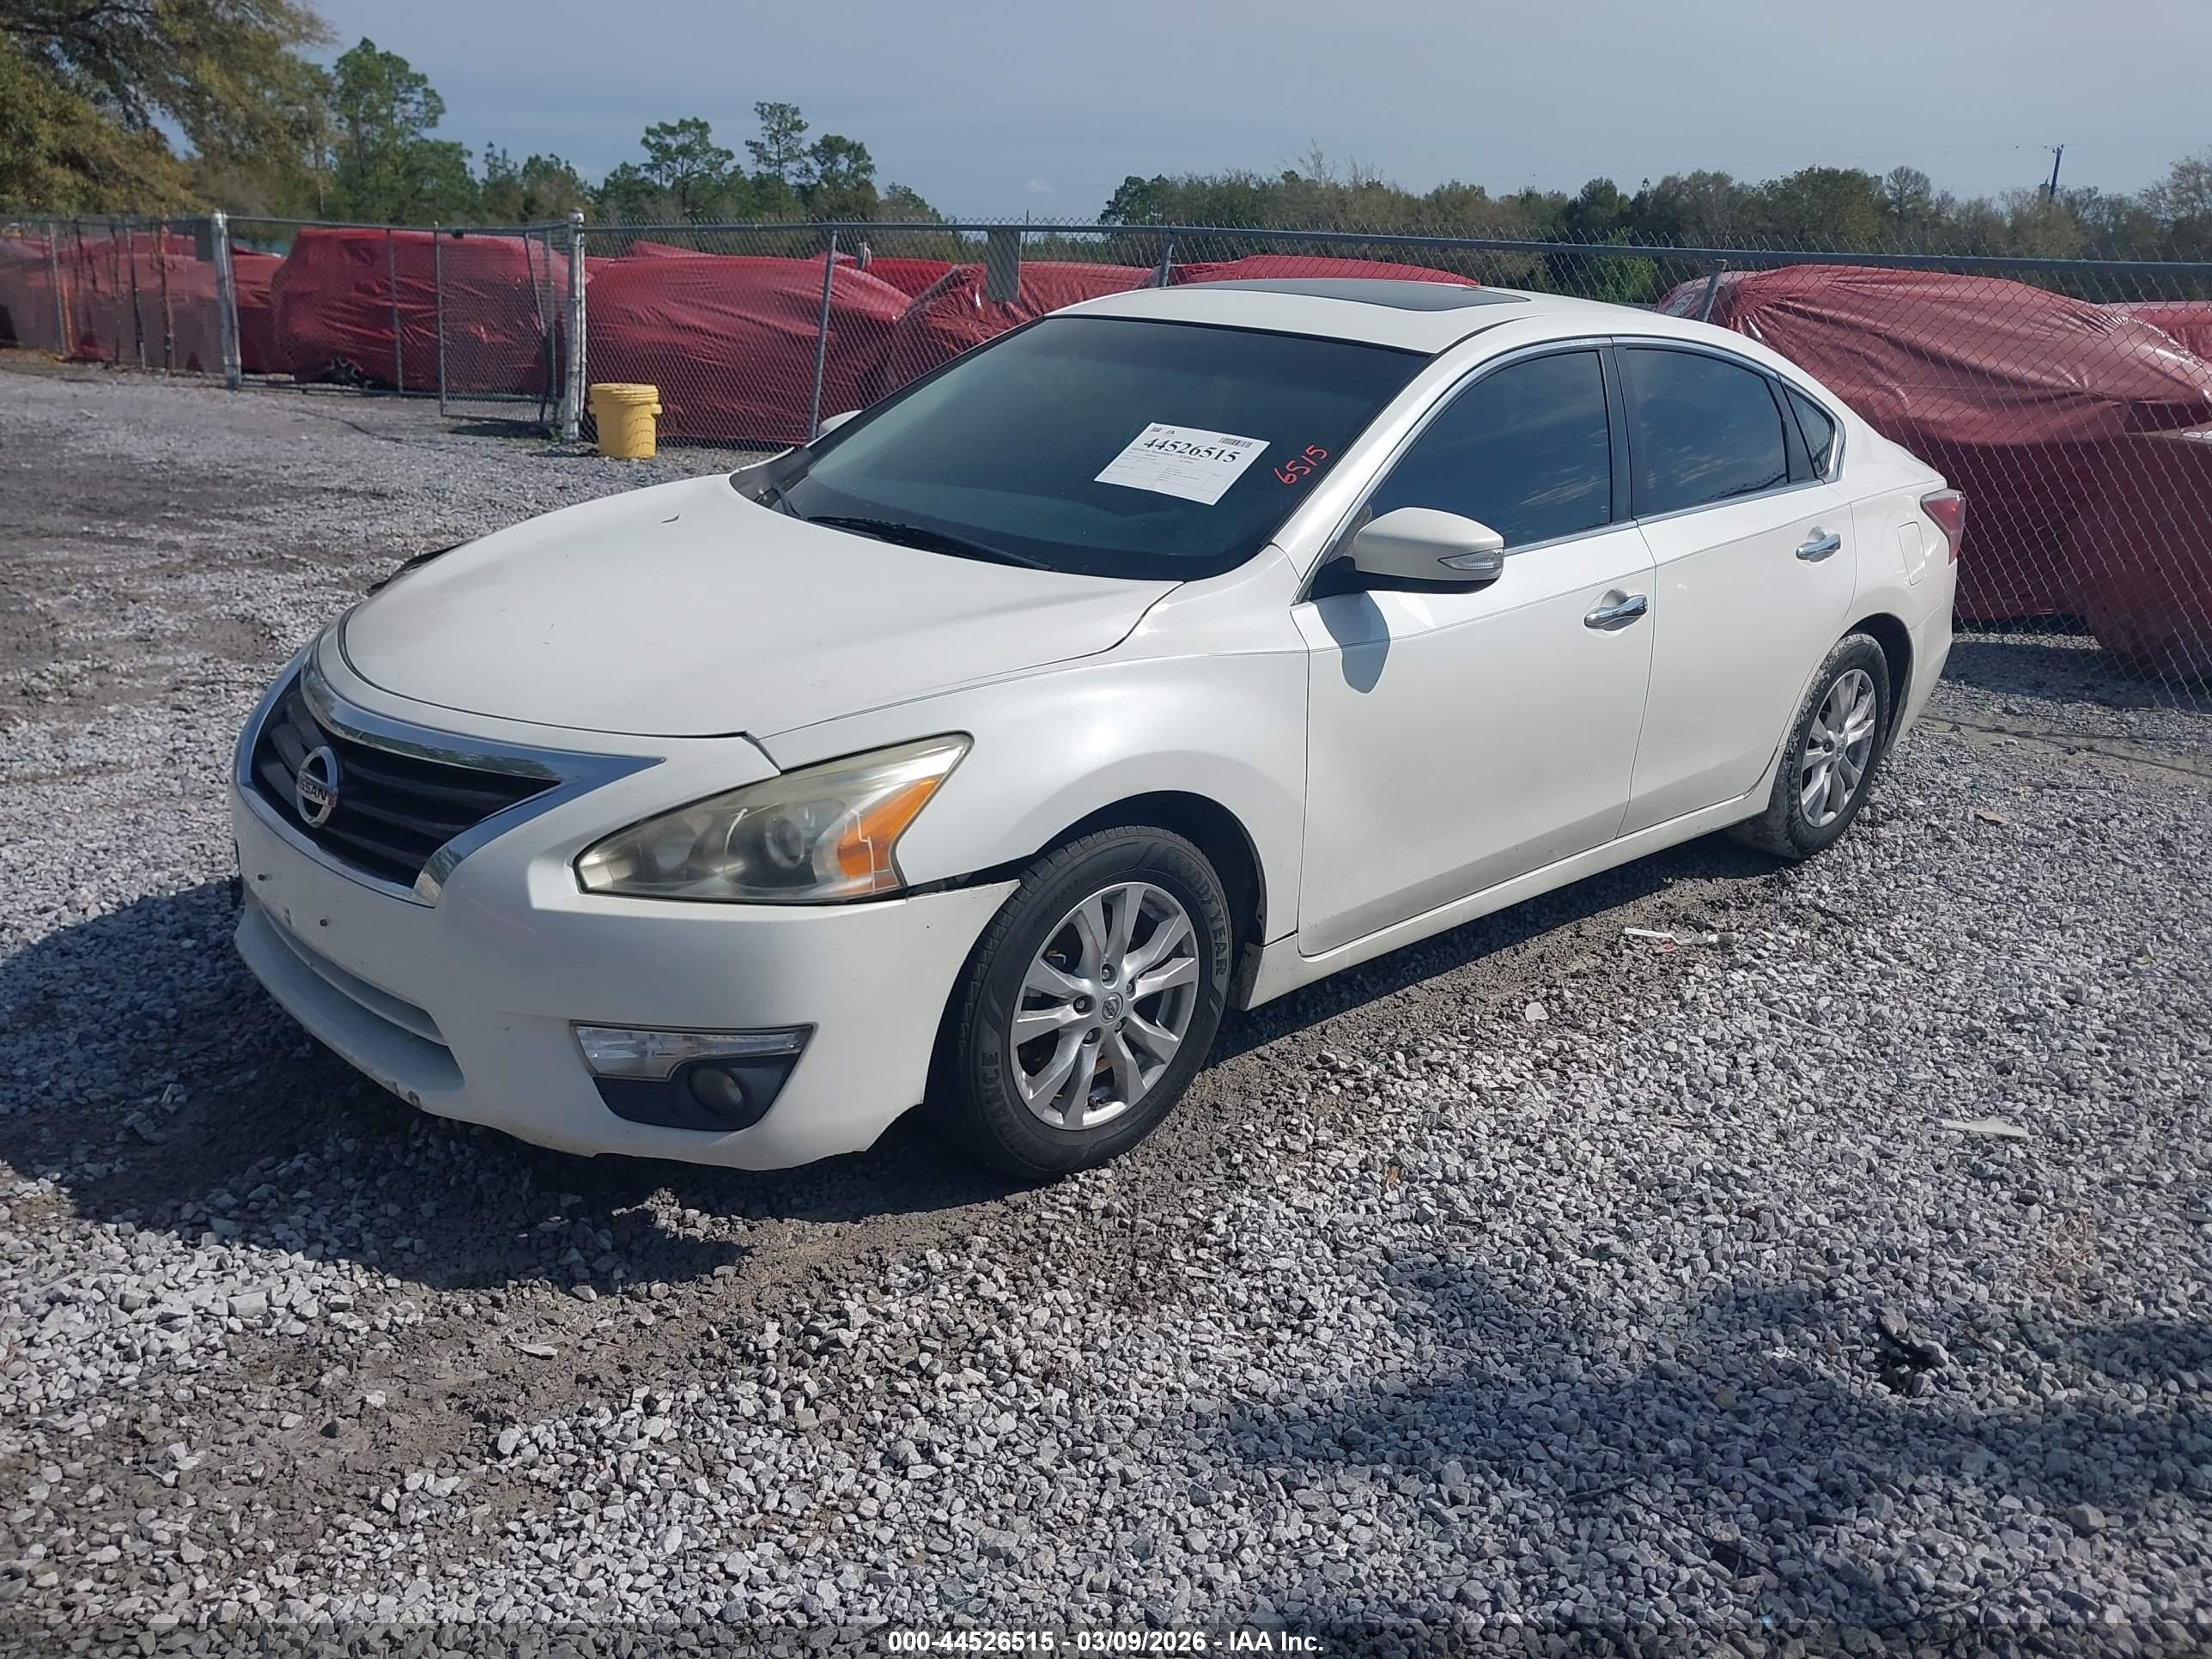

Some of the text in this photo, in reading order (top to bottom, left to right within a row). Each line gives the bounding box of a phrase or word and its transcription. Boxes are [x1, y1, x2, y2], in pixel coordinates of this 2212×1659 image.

[1144, 438, 1242, 463] 44526515
[1274, 445, 1328, 484] 6515
[299, 776, 327, 801] SSAN
